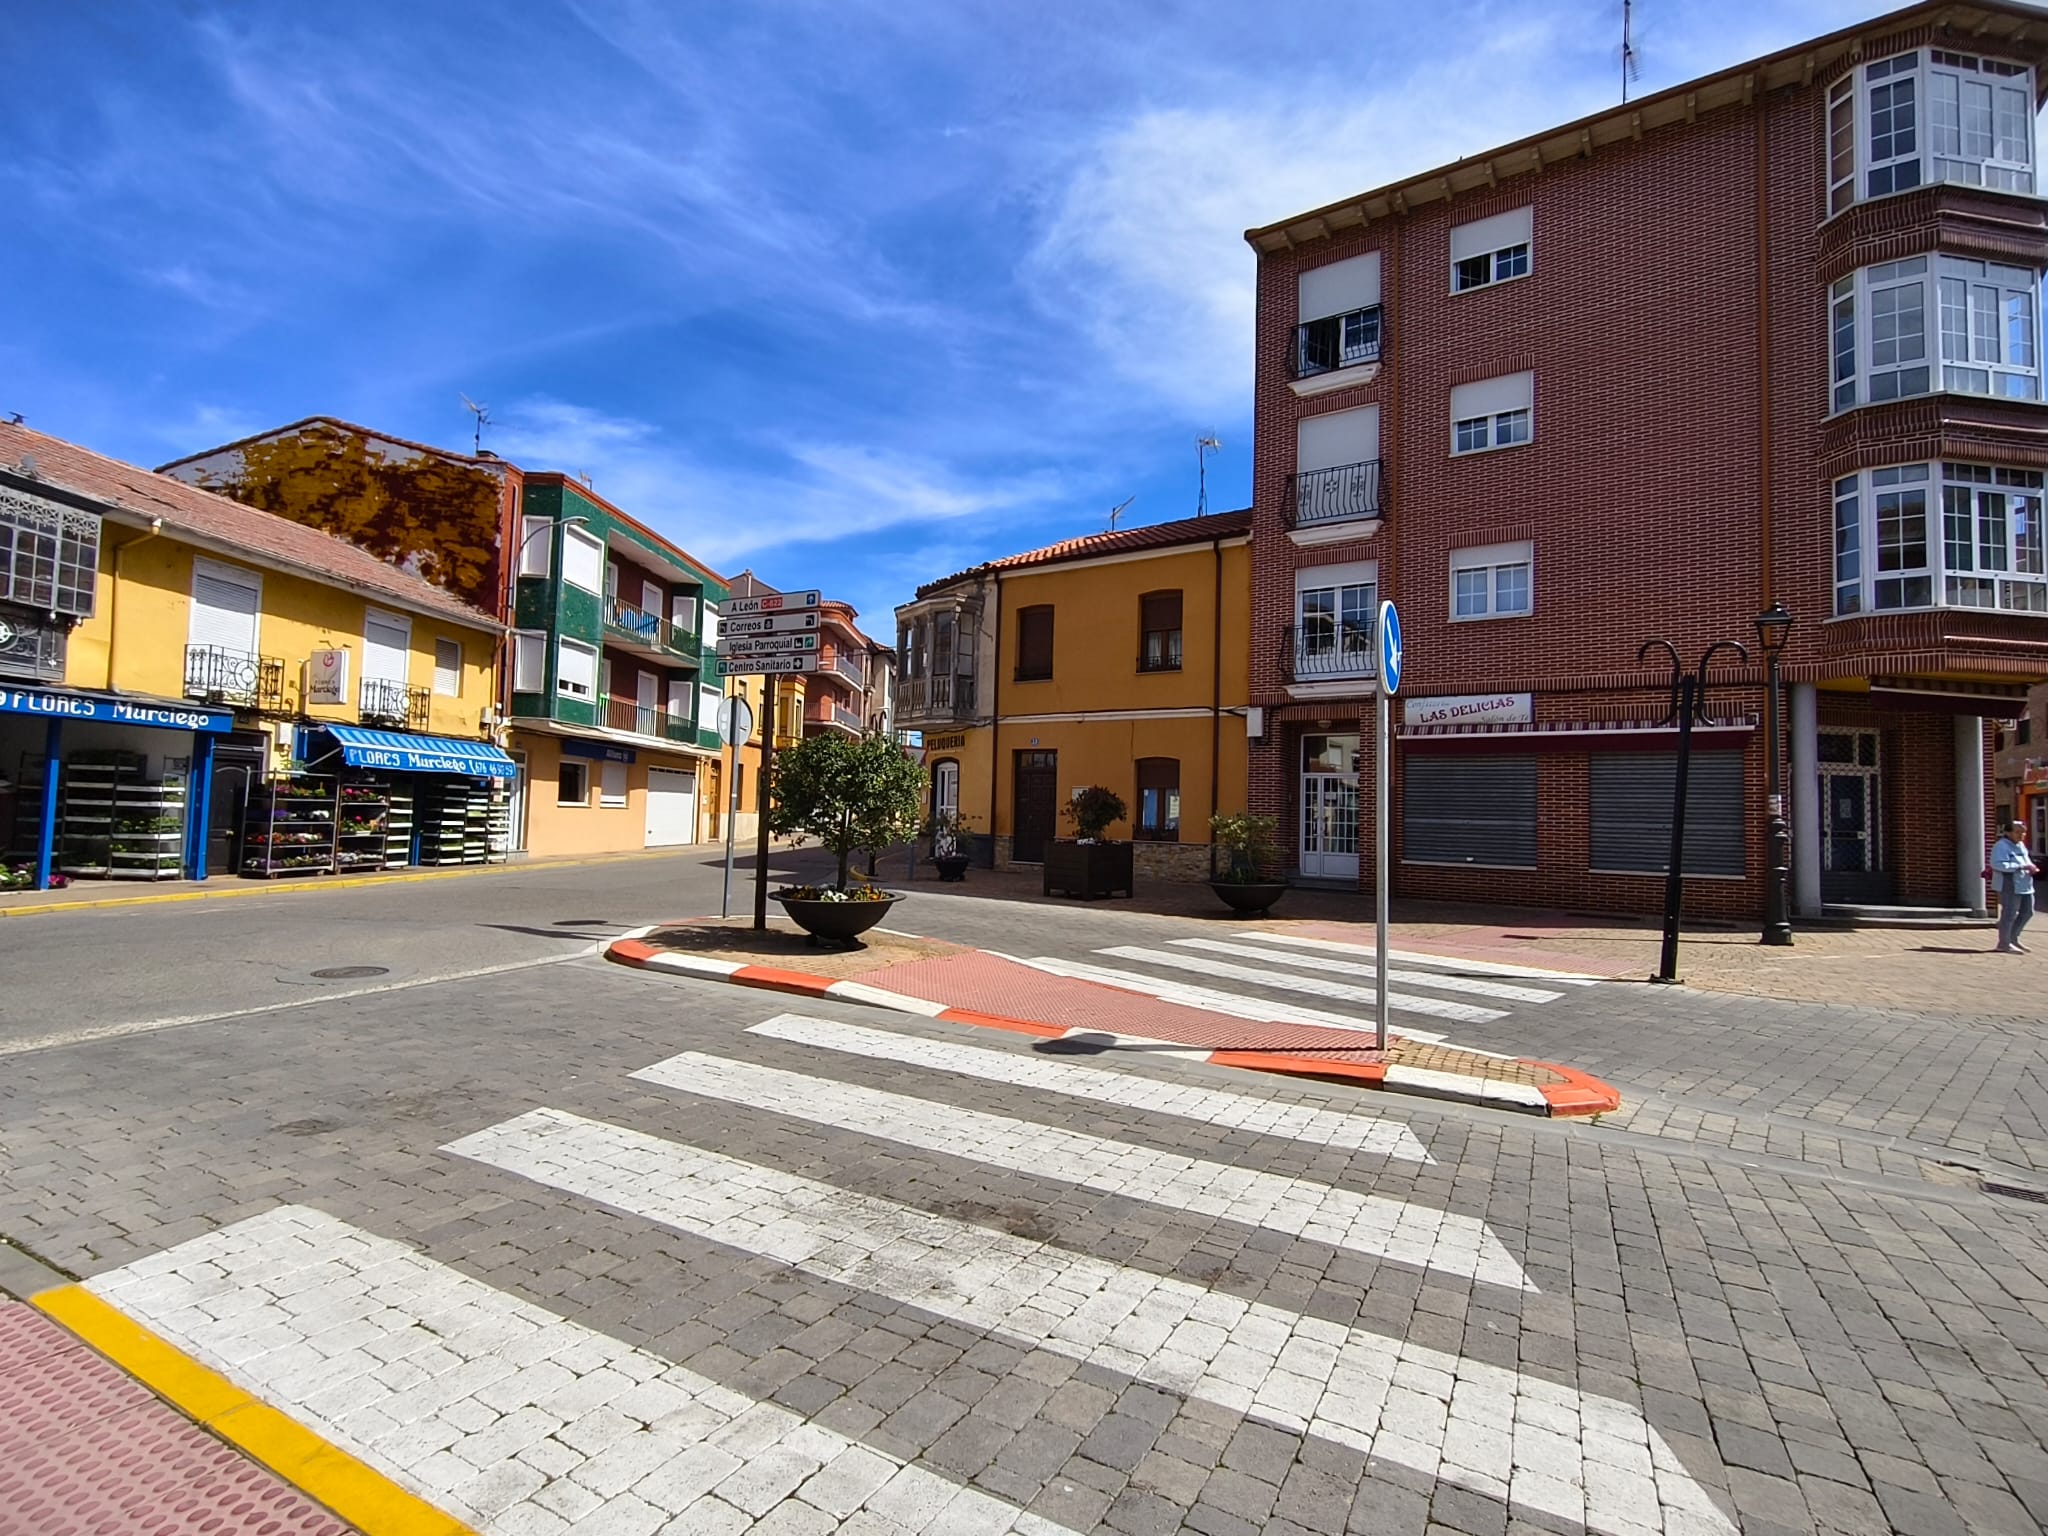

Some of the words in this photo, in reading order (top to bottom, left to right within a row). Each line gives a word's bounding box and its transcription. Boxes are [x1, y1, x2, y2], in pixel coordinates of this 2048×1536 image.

[731, 602, 737, 612] A
[739, 601, 758, 612] León
[730, 621, 761, 632] Correos
[729, 641, 752, 654] Iglesia
[754, 638, 792, 652] Parroquial
[728, 662, 754, 672] Centro
[755, 660, 791, 671] Sanitario
[112, 701, 209, 729] Murciego
[1420, 709, 1447, 723] LAS
[1450, 696, 1515, 718] DELICIAS
[407, 753, 467, 773] Murciego
